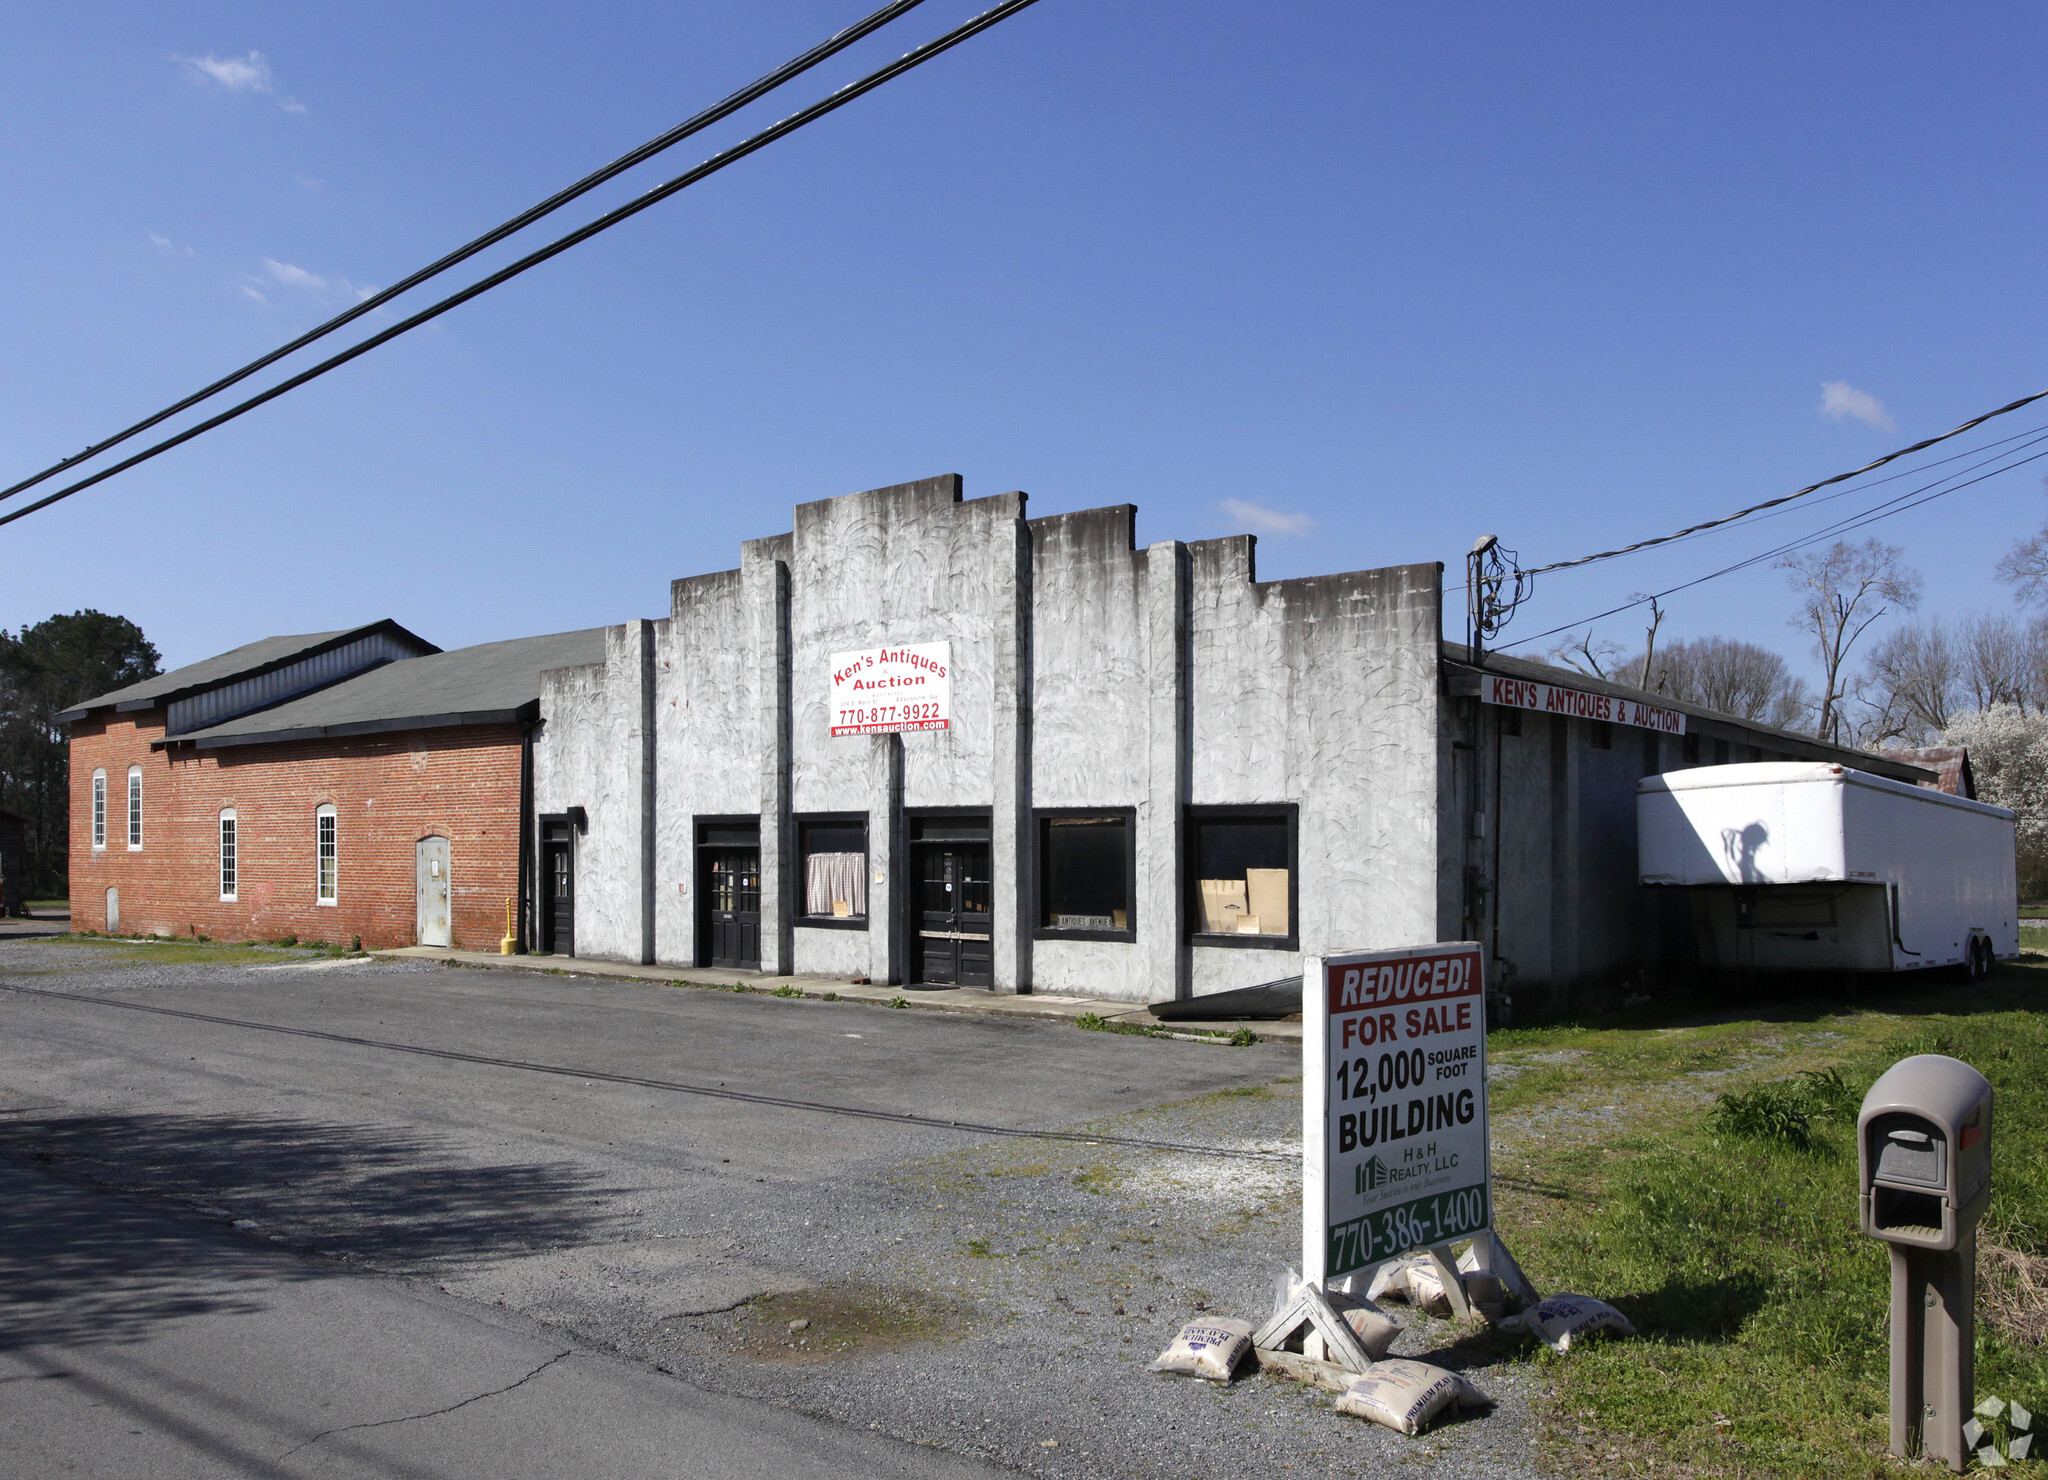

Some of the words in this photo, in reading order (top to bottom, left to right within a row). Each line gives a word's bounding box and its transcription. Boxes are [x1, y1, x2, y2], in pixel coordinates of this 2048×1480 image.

[834, 656, 873, 686] Ken's
[880, 649, 947, 678] Antiques
[853, 675, 925, 690] Auction
[840, 703, 940, 724] 770-877-9922
[1493, 677, 1537, 708] KEN'S
[1546, 687, 1611, 720] ANTIQUES
[1617, 701, 1626, 722] &
[1634, 704, 1680, 732] AUCTION
[835, 720, 945, 735] www.kensauction.com
[1061, 917, 1086, 926] ANTIQUES
[1089, 917, 1108, 927] AVENUE
[1341, 957, 1472, 1006] REDUCED!
[1342, 1012, 1398, 1049] FOR
[1406, 1002, 1472, 1039] SALE
[1427, 1045, 1477, 1066] SQUARE
[1337, 1048, 1426, 1104] 12,000
[1436, 1062, 1468, 1081] FOOT
[1339, 1088, 1475, 1154] BUILDING
[1389, 1161, 1432, 1183] REALTY,
[1435, 1153, 1459, 1173] LLC
[1403, 1147, 1414, 1163] H
[1416, 1147, 1424, 1159] &
[1427, 1142, 1437, 1157] H
[1363, 1194, 1378, 1206] Your
[1424, 1175, 1451, 1188] Business
[1333, 1187, 1484, 1272] 770-386-1400
[1182, 1333, 1222, 1347] PREMIUM
[1225, 1336, 1250, 1369] PREMIUM
[1405, 1387, 1436, 1421] PREMIUM
[1433, 1375, 1452, 1392] PLAY
